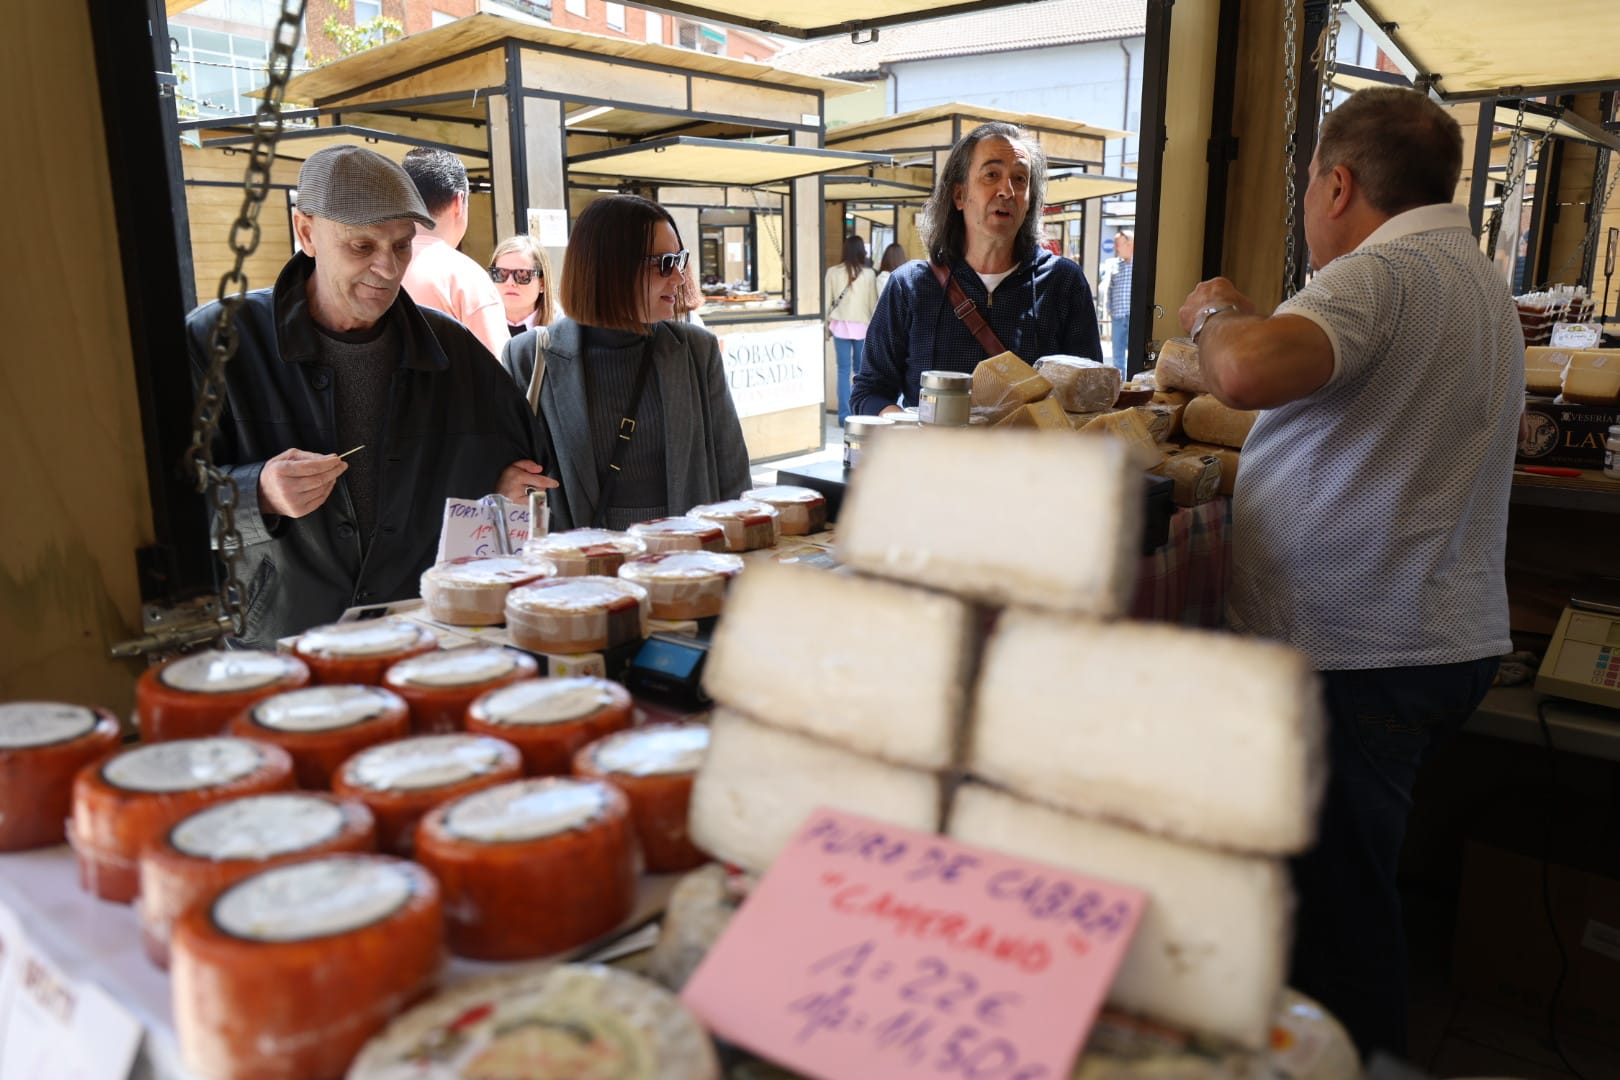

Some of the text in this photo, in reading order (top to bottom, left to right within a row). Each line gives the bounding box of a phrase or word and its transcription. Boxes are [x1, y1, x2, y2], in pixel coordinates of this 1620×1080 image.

[728, 340, 794, 369] SOBAOS
[730, 362, 804, 390] UESADAS
[450, 503, 480, 518] TORT
[985, 868, 1132, 944] CABRA
